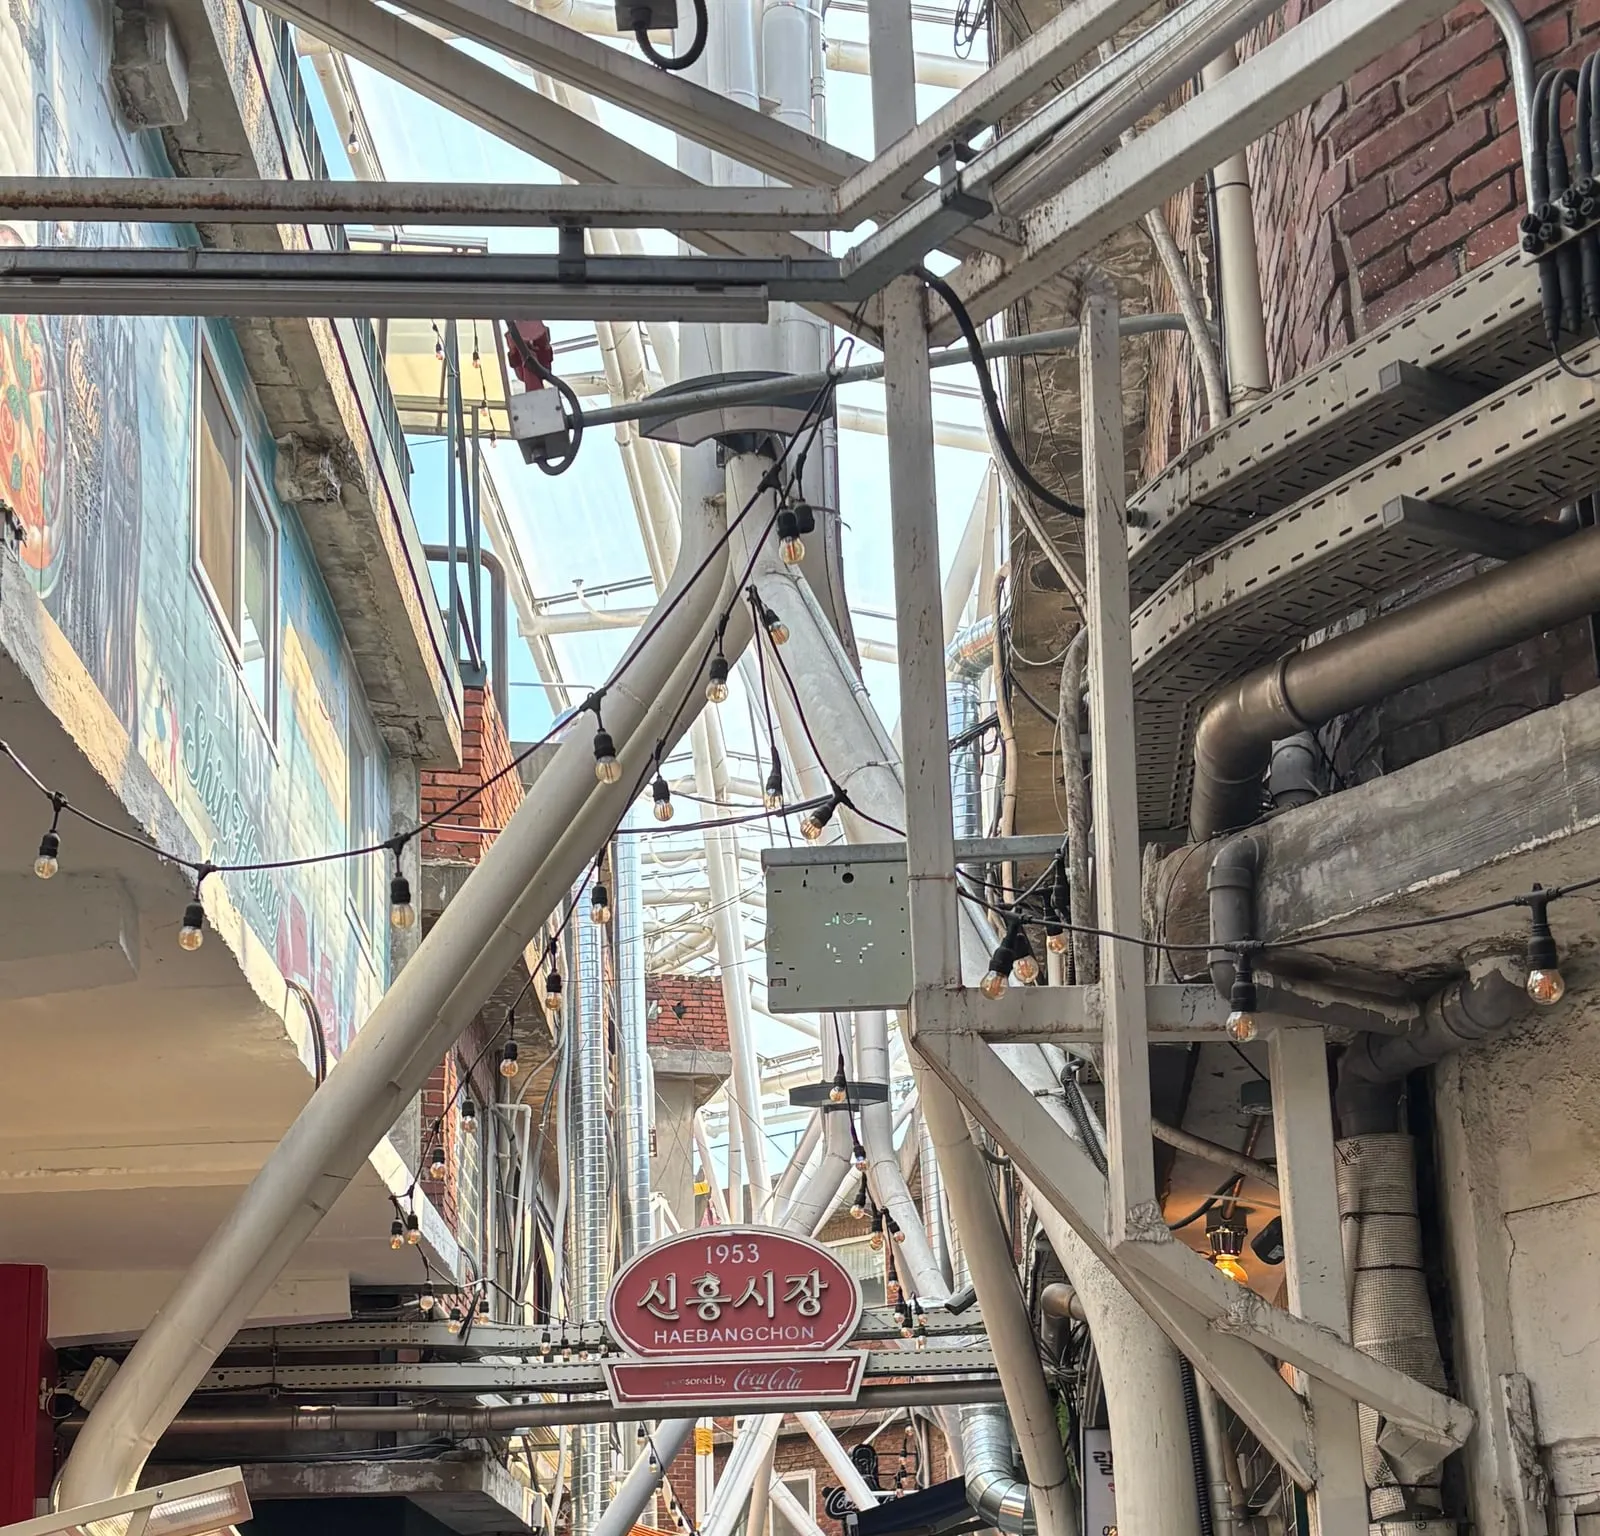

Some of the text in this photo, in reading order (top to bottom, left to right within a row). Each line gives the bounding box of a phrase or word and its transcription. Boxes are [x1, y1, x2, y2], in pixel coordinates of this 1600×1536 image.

[706, 1243, 760, 1265] 1953
[637, 1267, 829, 1321] 신흥시장
[654, 1326, 815, 1345] HAEBANGCHON
[714, 1375, 727, 1387] by
